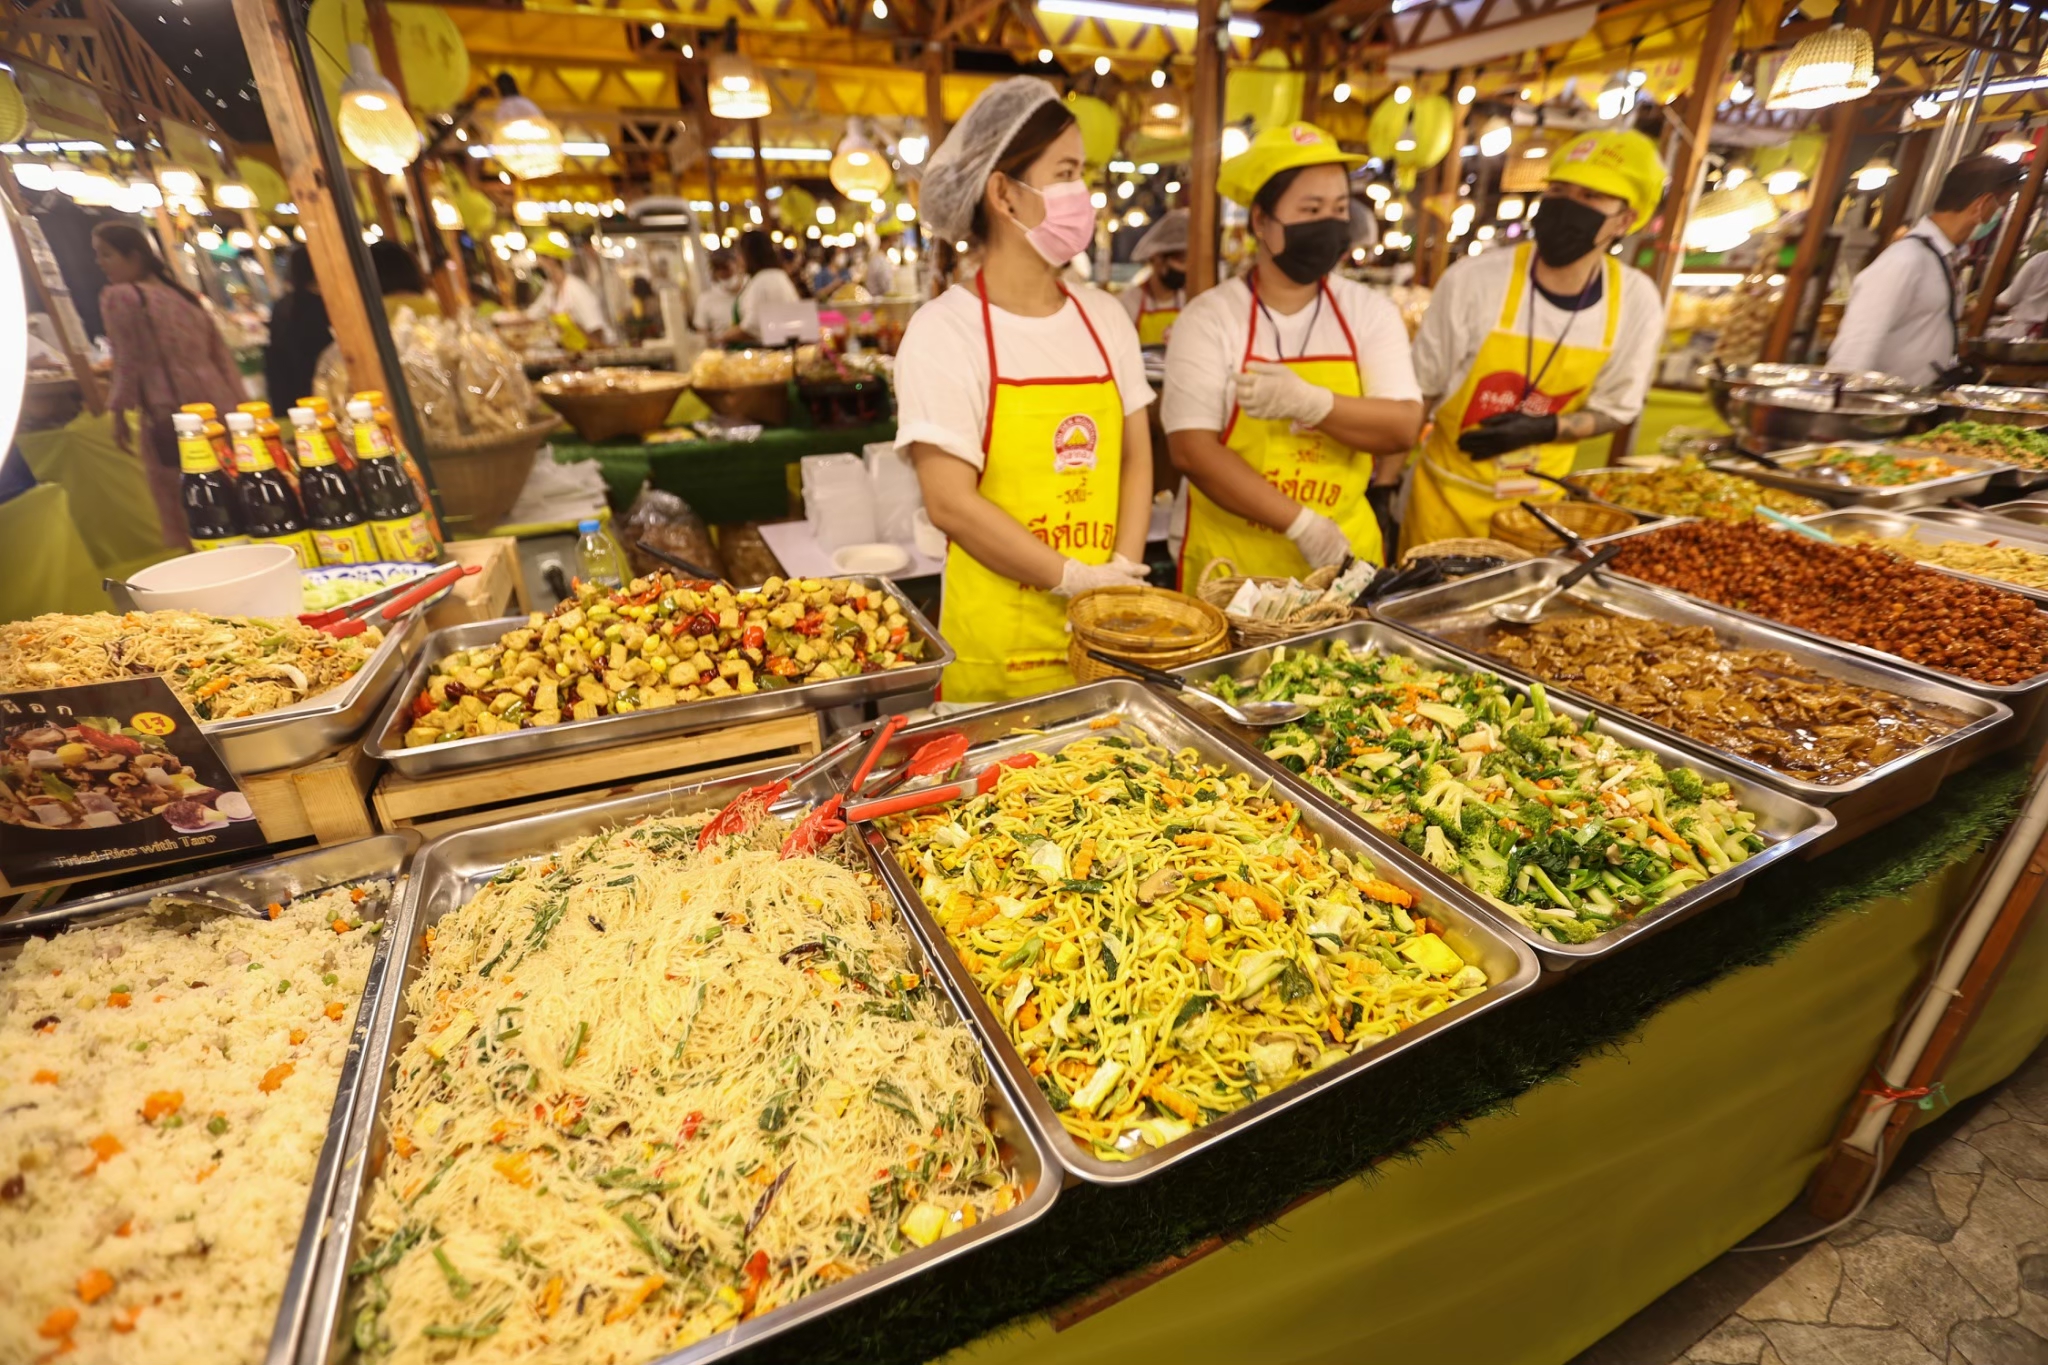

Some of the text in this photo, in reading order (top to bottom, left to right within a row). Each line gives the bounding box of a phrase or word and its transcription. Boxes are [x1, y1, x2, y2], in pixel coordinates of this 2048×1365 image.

[57, 834, 216, 868] Fried Rice with Taro
